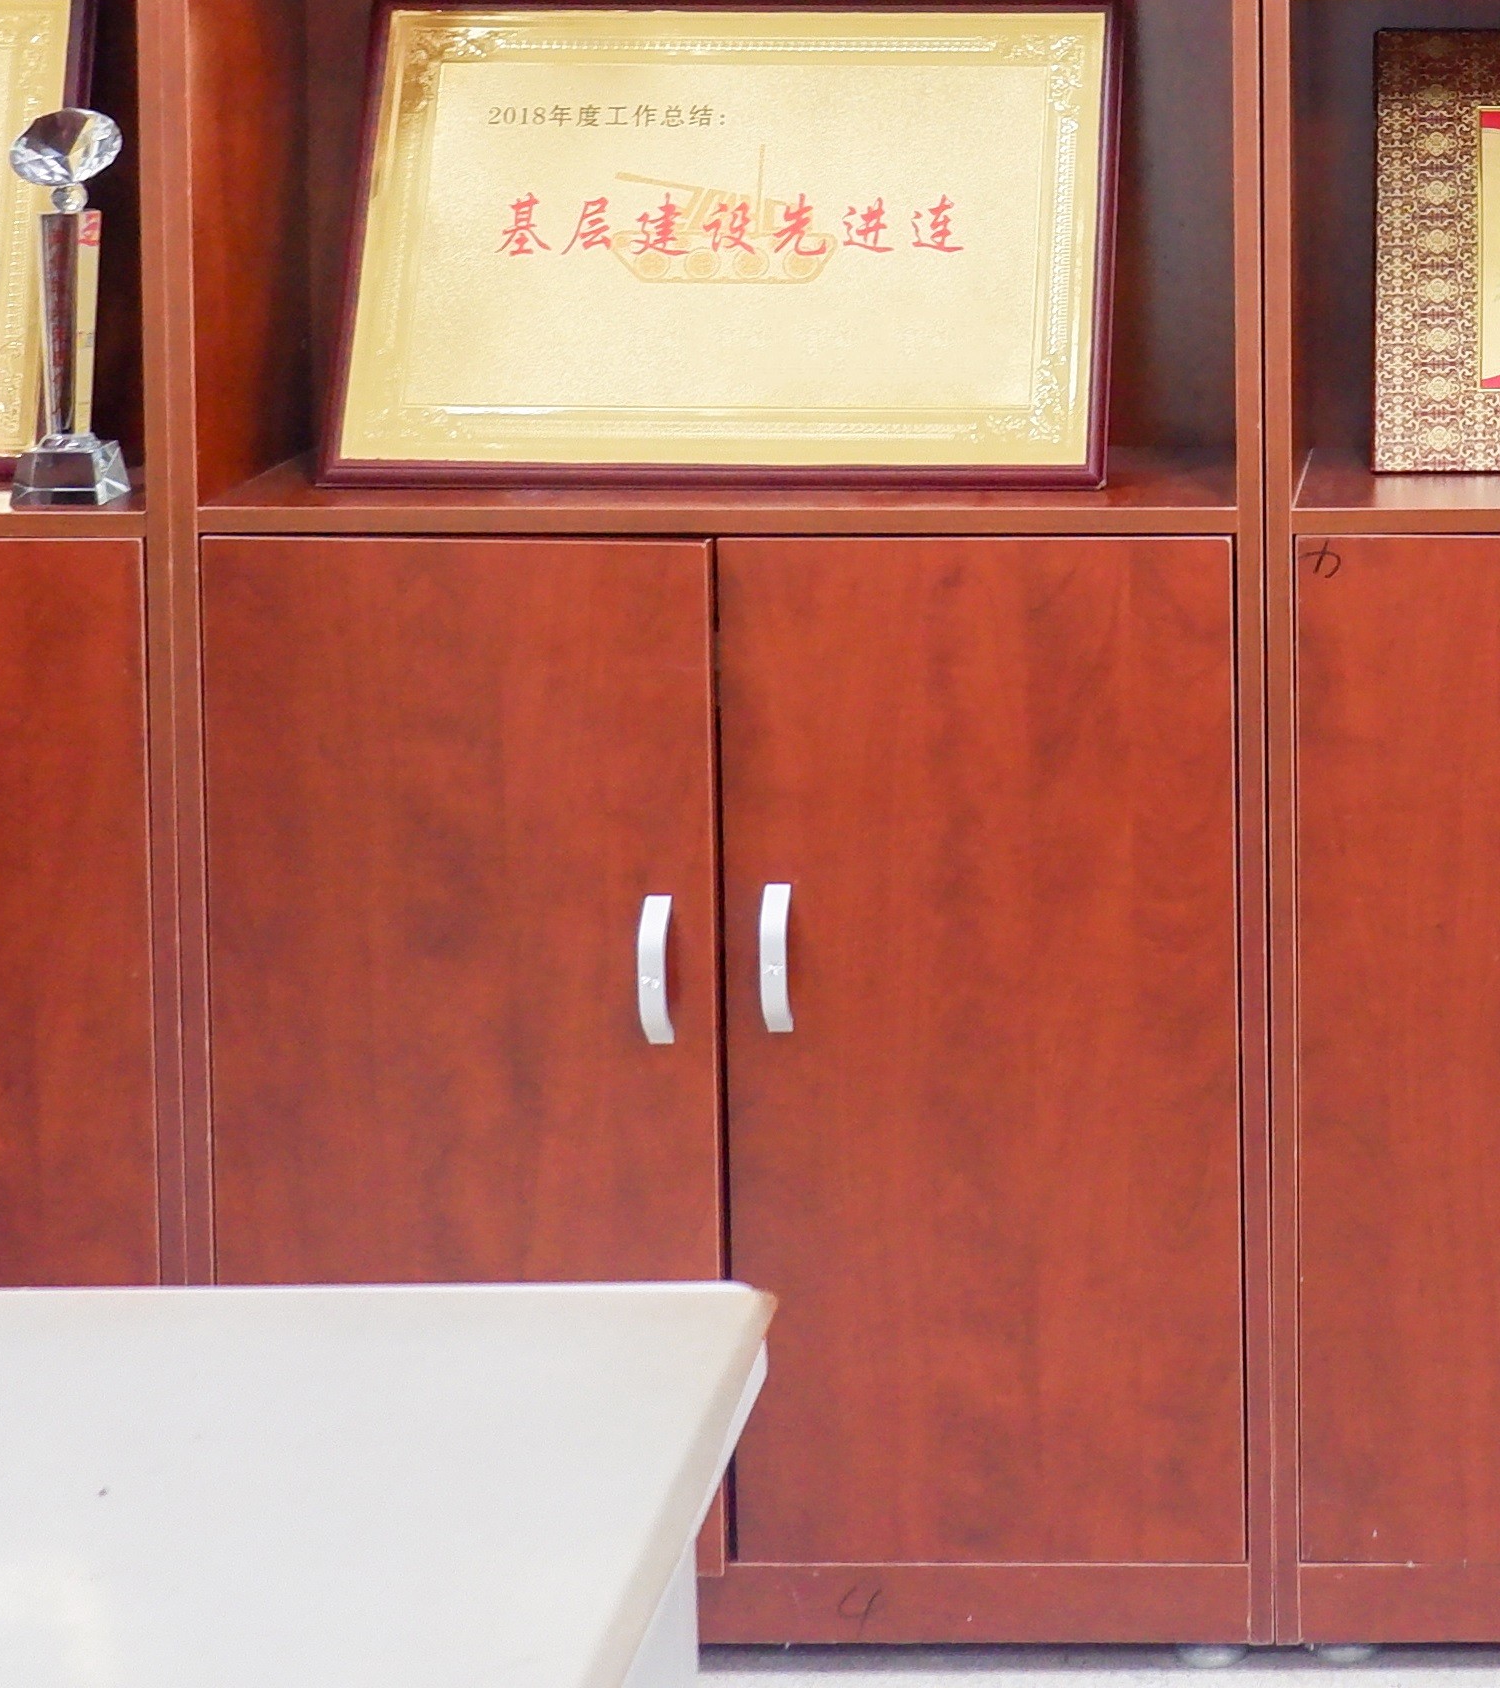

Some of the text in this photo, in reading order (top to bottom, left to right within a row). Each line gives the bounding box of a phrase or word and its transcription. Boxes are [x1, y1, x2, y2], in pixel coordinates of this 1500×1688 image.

[495, 191, 966, 258] 基层建设先进连
